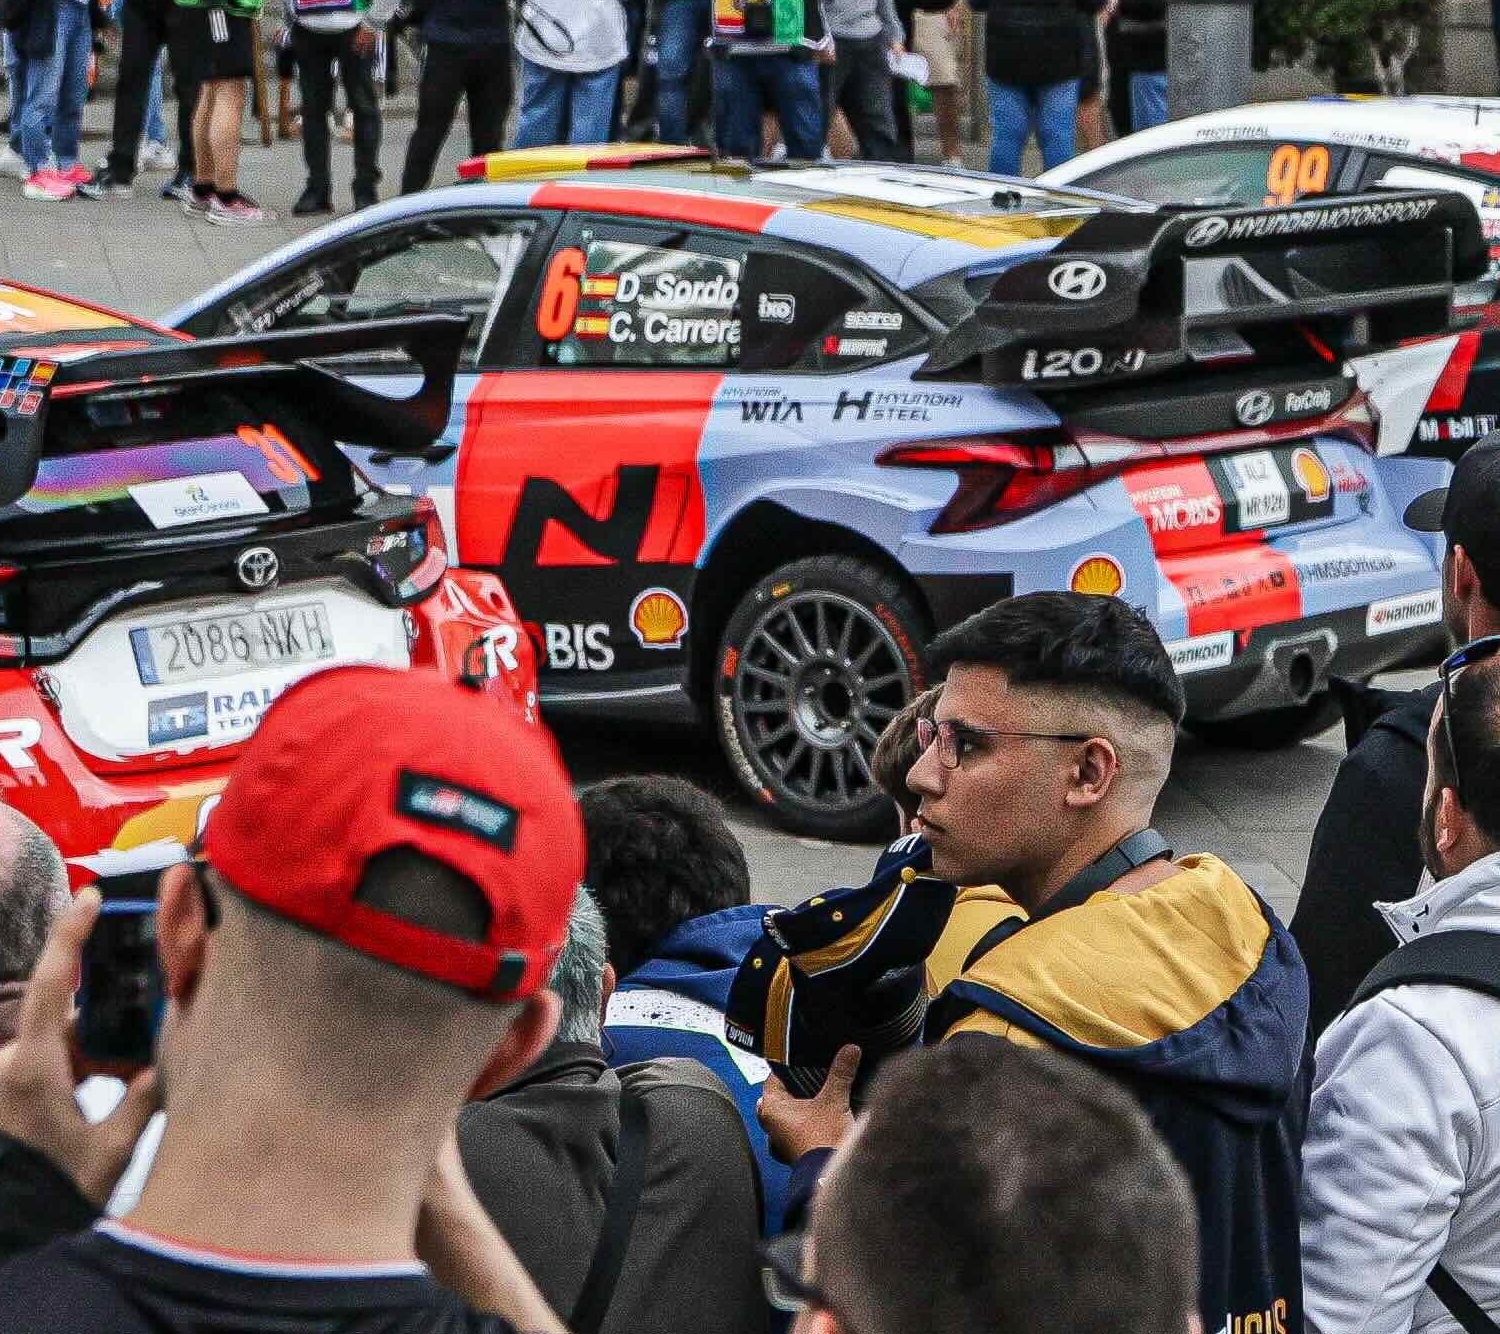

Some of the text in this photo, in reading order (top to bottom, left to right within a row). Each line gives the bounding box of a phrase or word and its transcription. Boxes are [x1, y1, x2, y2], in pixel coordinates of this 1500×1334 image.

[1263, 142, 1330, 209] 99
[537, 247, 588, 340] 6
[616, 270, 740, 309] D. Sordo
[609, 312, 637, 344] C.
[740, 397, 805, 425] WIA
[874, 409, 933, 423] STEEL
[1419, 419, 1475, 442] Mobil
[236, 422, 320, 485] 31
[1149, 497, 1222, 532] MOBIS
[161, 609, 333, 676] 2086 NKH
